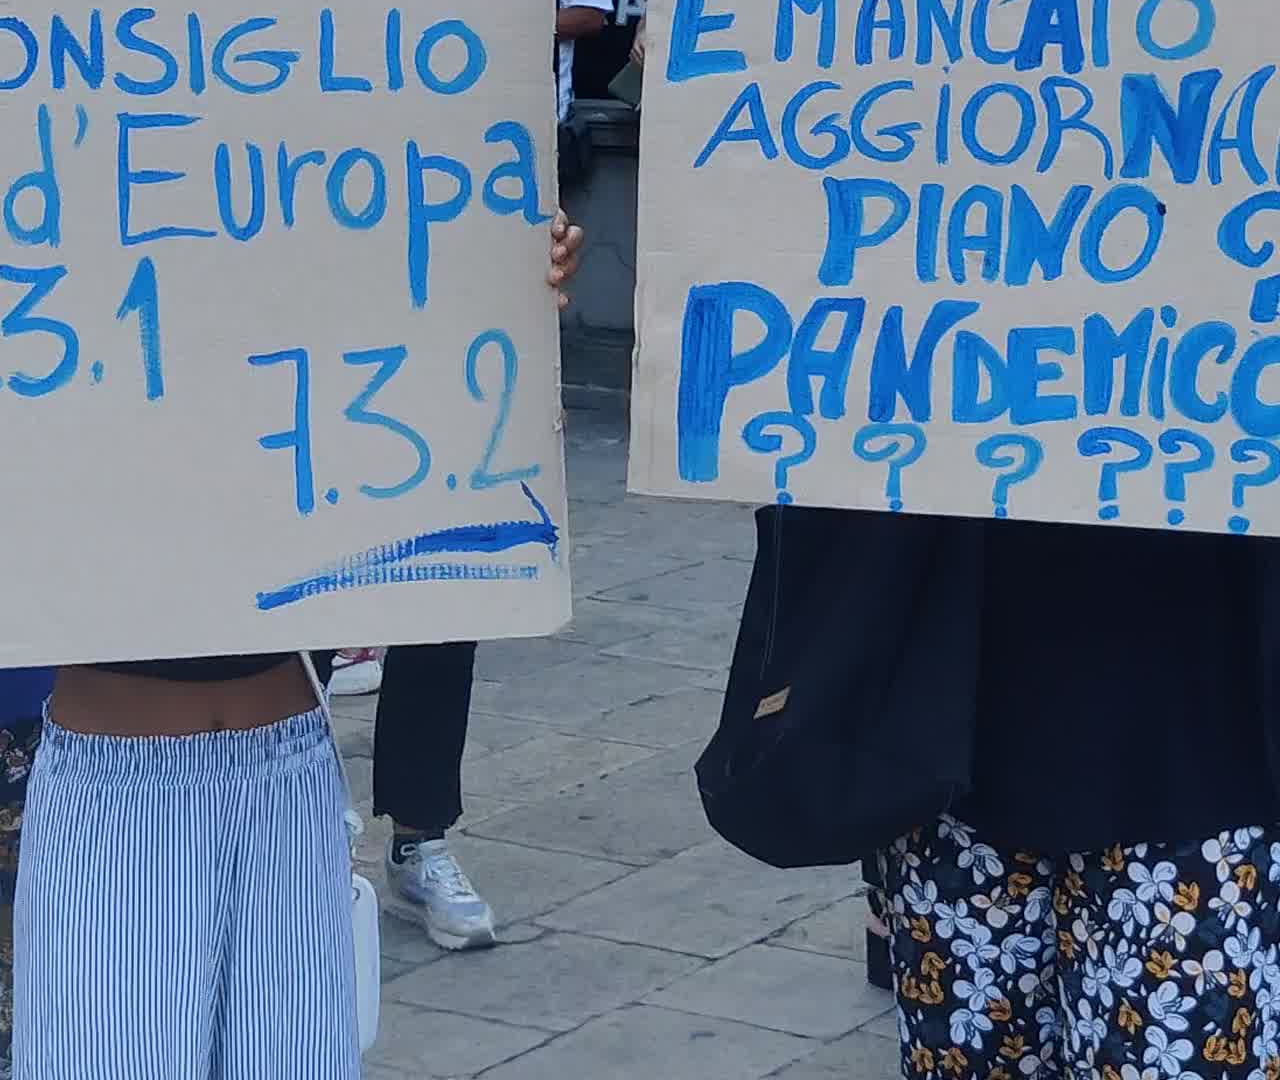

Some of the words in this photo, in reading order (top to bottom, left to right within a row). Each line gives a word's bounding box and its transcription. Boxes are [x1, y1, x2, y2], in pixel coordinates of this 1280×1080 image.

[2, 104, 553, 310] d'Europa
[816, 175, 1166, 288] PIANO
[247, 328, 542, 515] 7.3.2
